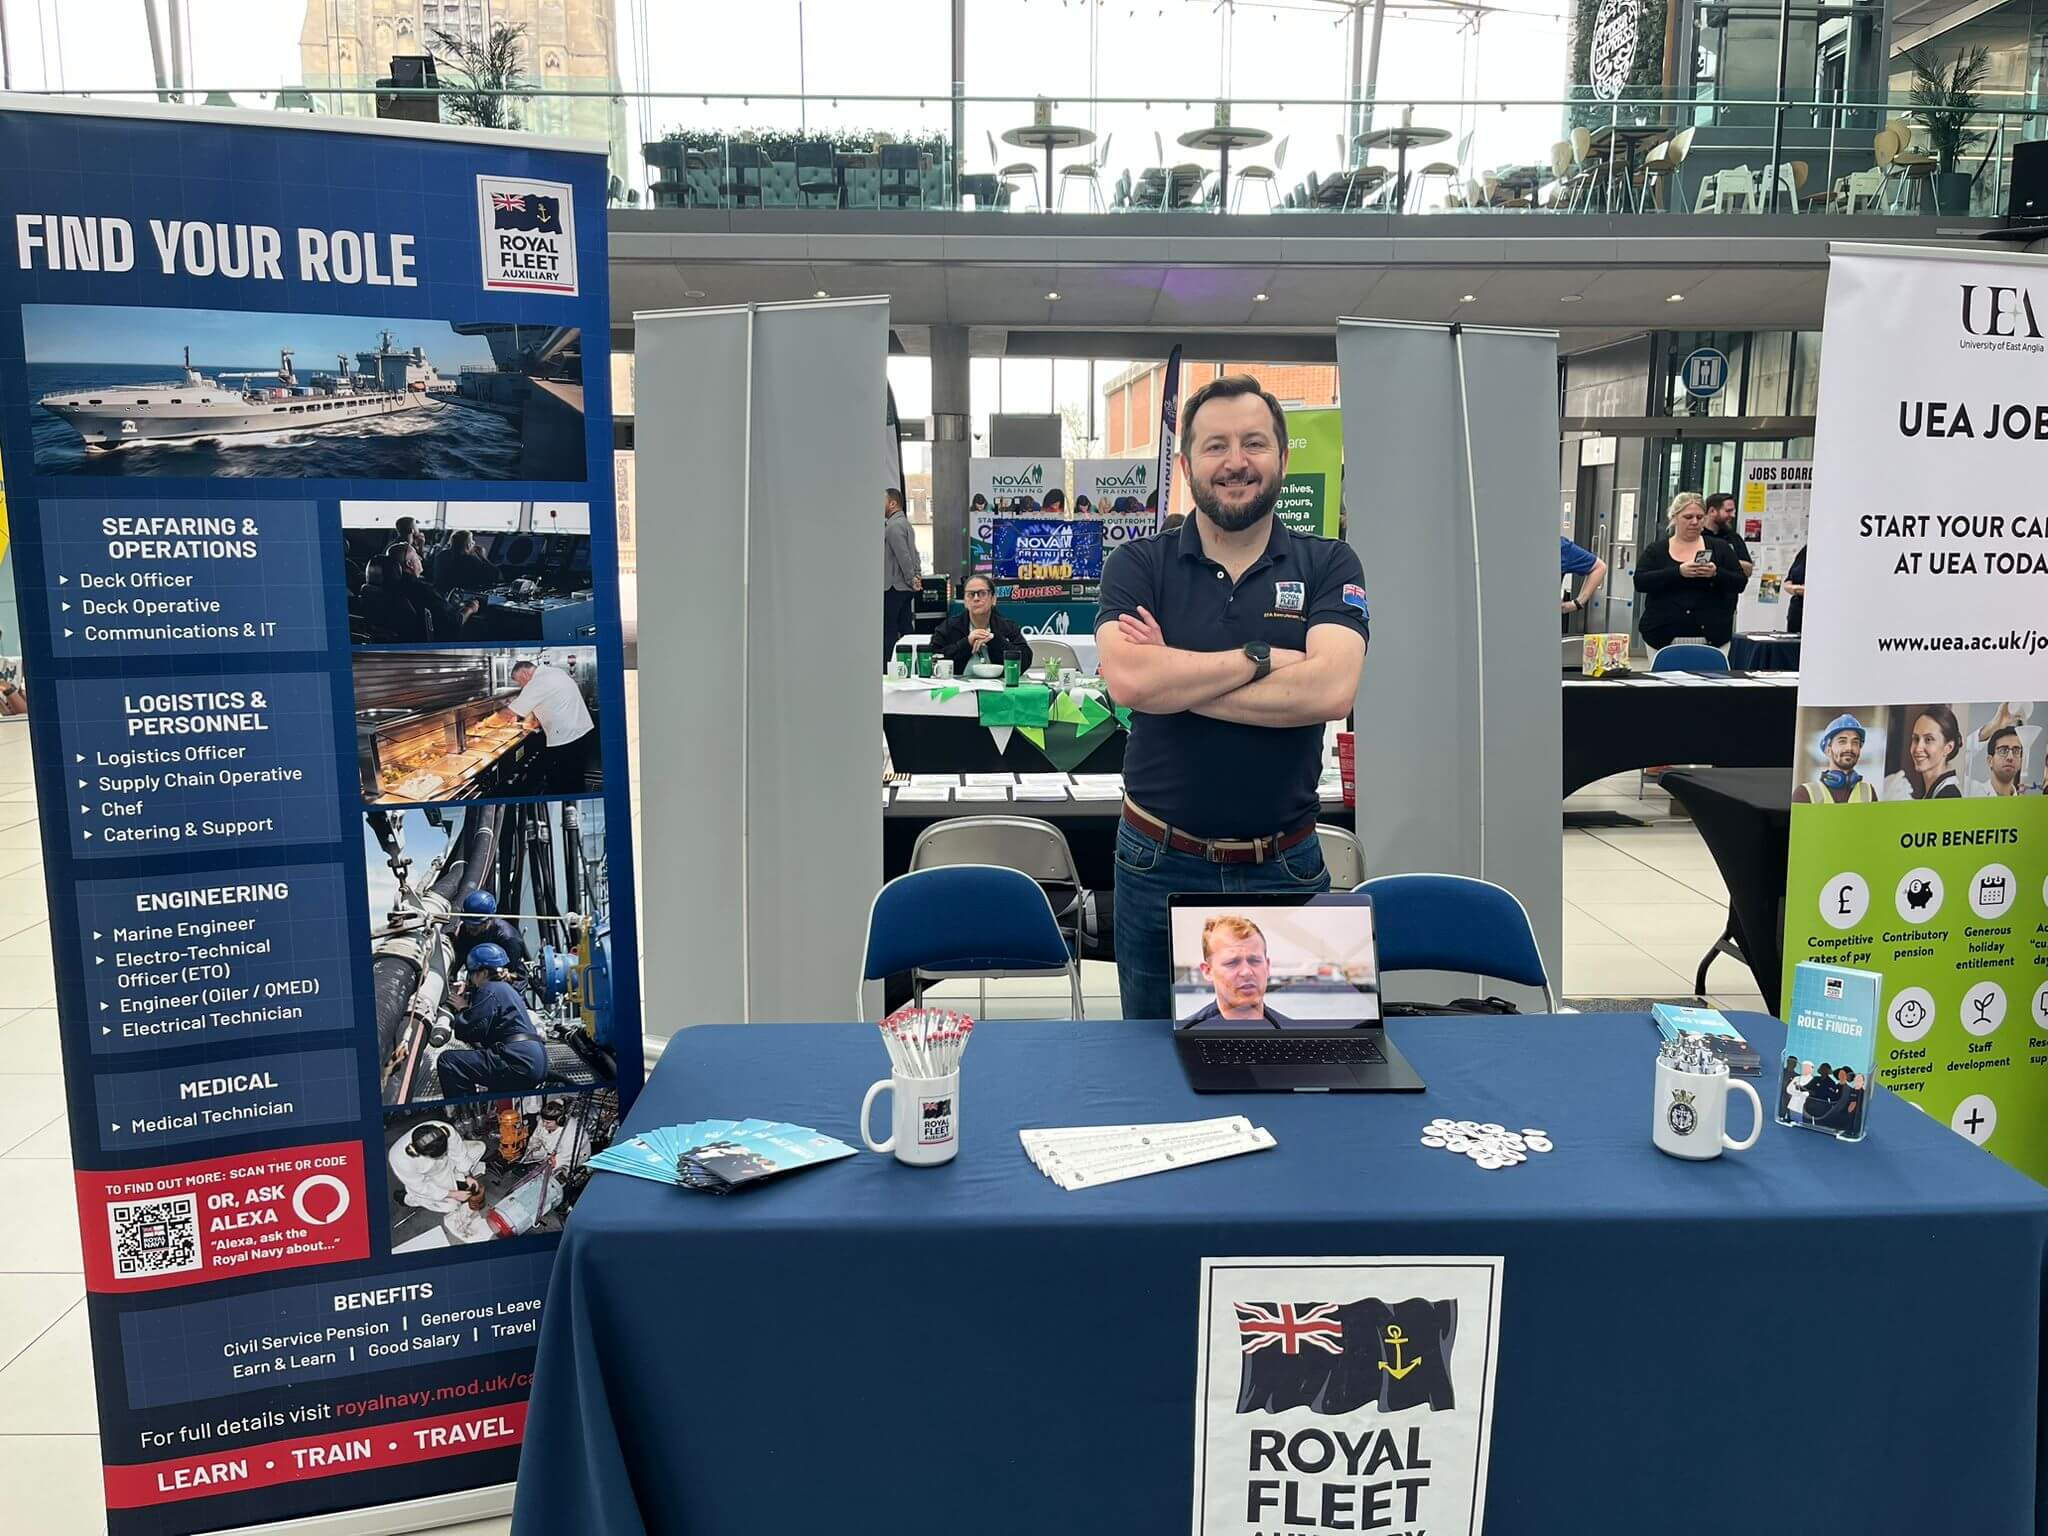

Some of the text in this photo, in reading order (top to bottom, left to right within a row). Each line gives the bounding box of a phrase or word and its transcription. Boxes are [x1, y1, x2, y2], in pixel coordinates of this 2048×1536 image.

[16, 213, 418, 287] FIND YOUR ROLE
[500, 235, 559, 253] ROYAL
[501, 252, 559, 270] FLEET
[503, 269, 559, 280] AUXILIARY
[1959, 284, 2045, 338] UEA
[1959, 340, 2045, 353] University of East Anglia
[1900, 401, 1975, 439] UEA
[992, 467, 1034, 486] NOVA
[1095, 467, 1138, 486] NOVA
[1749, 467, 1777, 480] JOBS
[1290, 484, 1314, 494] lives,
[1284, 500, 1313, 509] yours,
[102, 517, 259, 536] SEAFARING &
[1860, 515, 1930, 537] START
[1937, 515, 2004, 537] YOUR
[109, 540, 257, 559] OPERATIONS
[1017, 532, 1060, 548] NOVA
[1018, 563, 1073, 580] CROWD
[1894, 552, 1922, 574] AT
[1929, 552, 1977, 574] UEA
[80, 571, 193, 588] Deck Officer
[83, 598, 220, 616] Deck Operative
[85, 622, 276, 641] Communications & IT
[125, 691, 267, 714] LOGISTICS &
[128, 713, 269, 736] PERSONNEL
[97, 745, 246, 768] Logistics Officer
[99, 766, 302, 794] Supply Chain Operative
[101, 801, 144, 817] Chef
[104, 817, 273, 842] Catering & Support
[1900, 828, 2018, 849] OUR BENEFITS
[136, 882, 289, 912] ENGINEERING
[113, 917, 256, 943] Marine Engineer
[1882, 929, 1949, 944] Contributory
[1964, 926, 2012, 937] Generous
[1808, 935, 1874, 949] Competitive
[1968, 940, 2005, 954] holiday
[116, 939, 271, 967] Electro-Technical
[1808, 952, 1872, 964] rates of pay
[1894, 946, 1934, 961] pension
[1955, 957, 2015, 970] entitlement
[117, 963, 231, 988] Officer (ETO)
[120, 978, 320, 1014] Engineer (Oiler / QMED)
[122, 1006, 302, 1037] Electrical Technician
[1797, 1014, 1823, 1030] ROLE
[1825, 1019, 1863, 1037] FINDER
[1890, 1048, 1926, 1061] Ofsted
[1968, 1041, 1993, 1053] Staff
[1881, 1063, 1933, 1079] registered
[1946, 1057, 2010, 1071] development
[180, 1072, 278, 1100] MEDICAL
[1887, 1080, 1925, 1092] nursery
[131, 1101, 293, 1134] Medical Technician
[924, 1119, 949, 1128] ROYAL
[924, 1126, 949, 1136] FLEET
[105, 1184, 122, 1196] TO
[124, 1182, 154, 1195] FIND
[157, 1178, 183, 1191] OUT
[186, 1171, 227, 1187] MORE:
[230, 1165, 265, 1179] SCAN
[267, 1162, 292, 1174] THE
[314, 1155, 347, 1168] CODE
[207, 1184, 286, 1210] OR, ASK
[210, 1208, 278, 1232] ALEXA
[260, 1232, 283, 1245] ask
[286, 1227, 307, 1240] the
[212, 1251, 249, 1267] Royal
[251, 1245, 283, 1261] Navy
[334, 1283, 433, 1311] BENEFITS
[223, 1299, 542, 1357] Civil Service Pension Generous Leave
[233, 1320, 536, 1378] Earn & Learn Good Salary Travel
[140, 1431, 174, 1448] For
[179, 1422, 211, 1442] full
[216, 1411, 285, 1436] details
[289, 1404, 331, 1423] visit
[157, 1416, 514, 1492] LEARN TRAIN TRAVEL
[1249, 1427, 1431, 1476] ROYAL
[1247, 1477, 1430, 1531] FLEET
